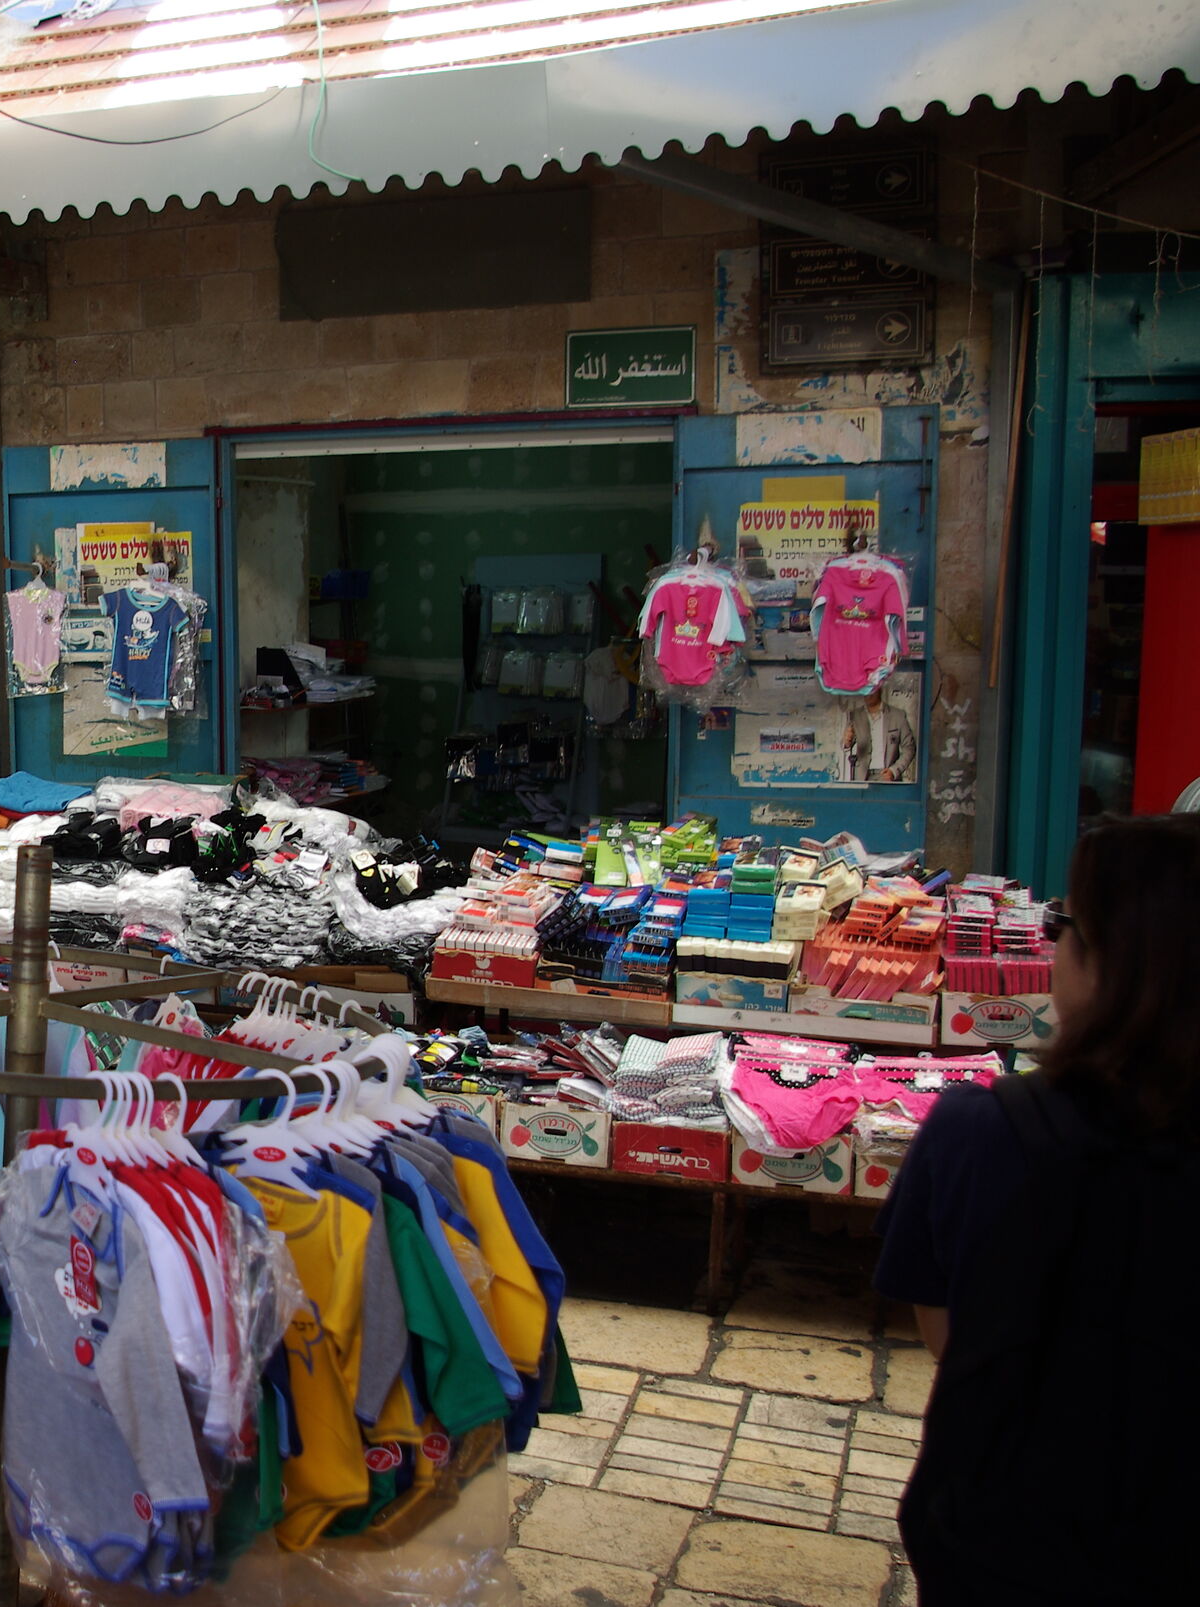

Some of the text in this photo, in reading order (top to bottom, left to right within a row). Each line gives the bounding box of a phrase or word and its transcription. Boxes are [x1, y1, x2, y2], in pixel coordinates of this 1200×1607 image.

[574, 351, 687, 387] استغفر الله
[741, 509, 786, 531] טשטש
[790, 504, 825, 530] סלים
[82, 542, 117, 561] טשטש
[120, 536, 148, 559] סלים
[781, 538, 812, 549] דירות
[114, 566, 136, 577] ירות
[538, 1119, 576, 1132] חרמון
